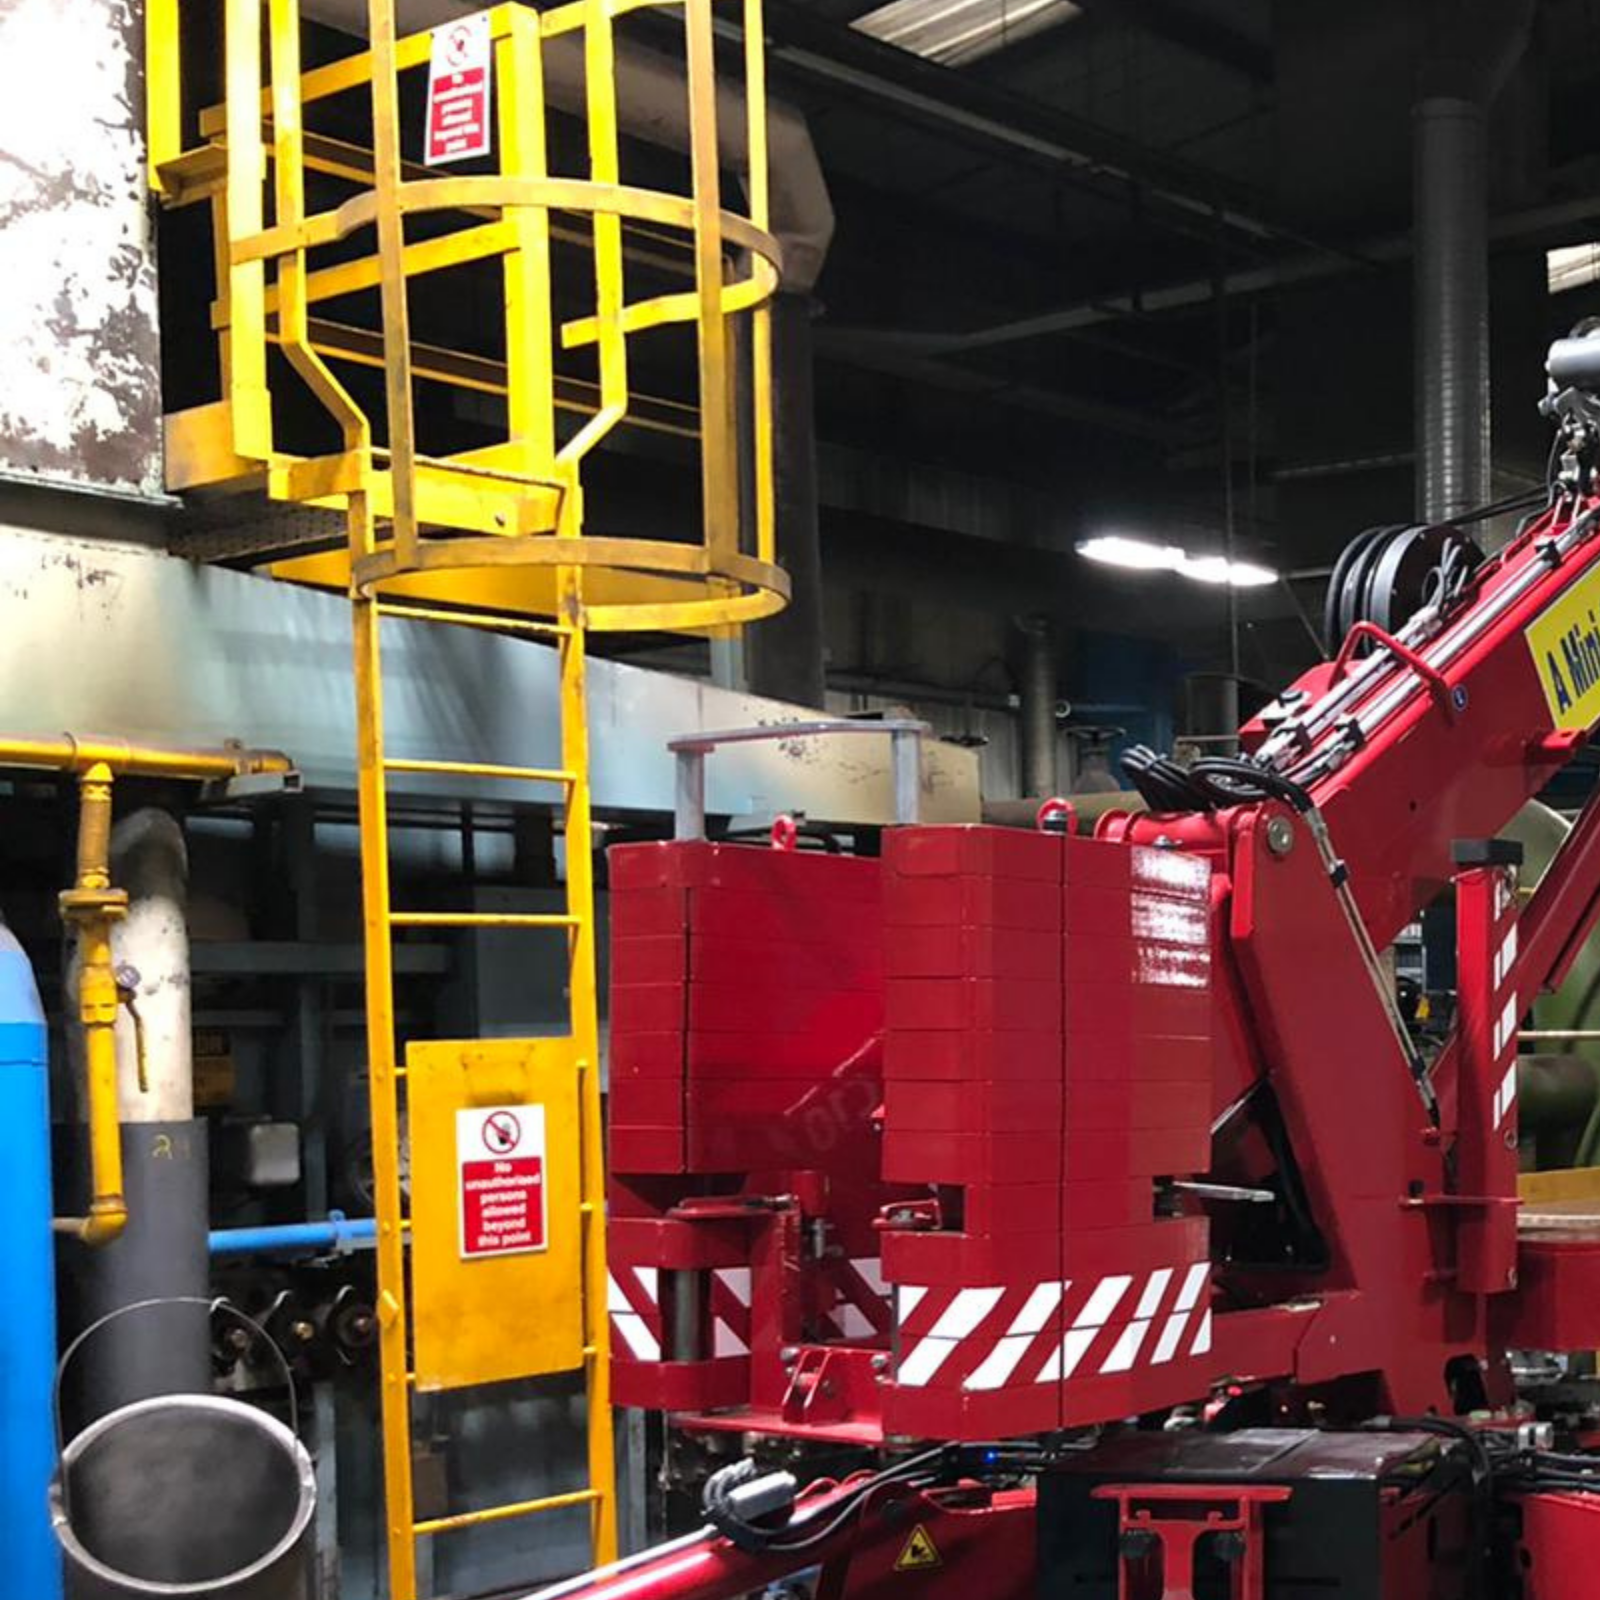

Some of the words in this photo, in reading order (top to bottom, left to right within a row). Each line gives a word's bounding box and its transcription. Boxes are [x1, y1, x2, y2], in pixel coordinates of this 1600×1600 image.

[1547, 651, 1572, 714] A
[494, 1162, 513, 1173] No
[480, 1191, 527, 1205] persons
[482, 1203, 527, 1218] allowed
[483, 1217, 527, 1233] beyond
[477, 1235, 499, 1247] this
[501, 1231, 532, 1247] point
